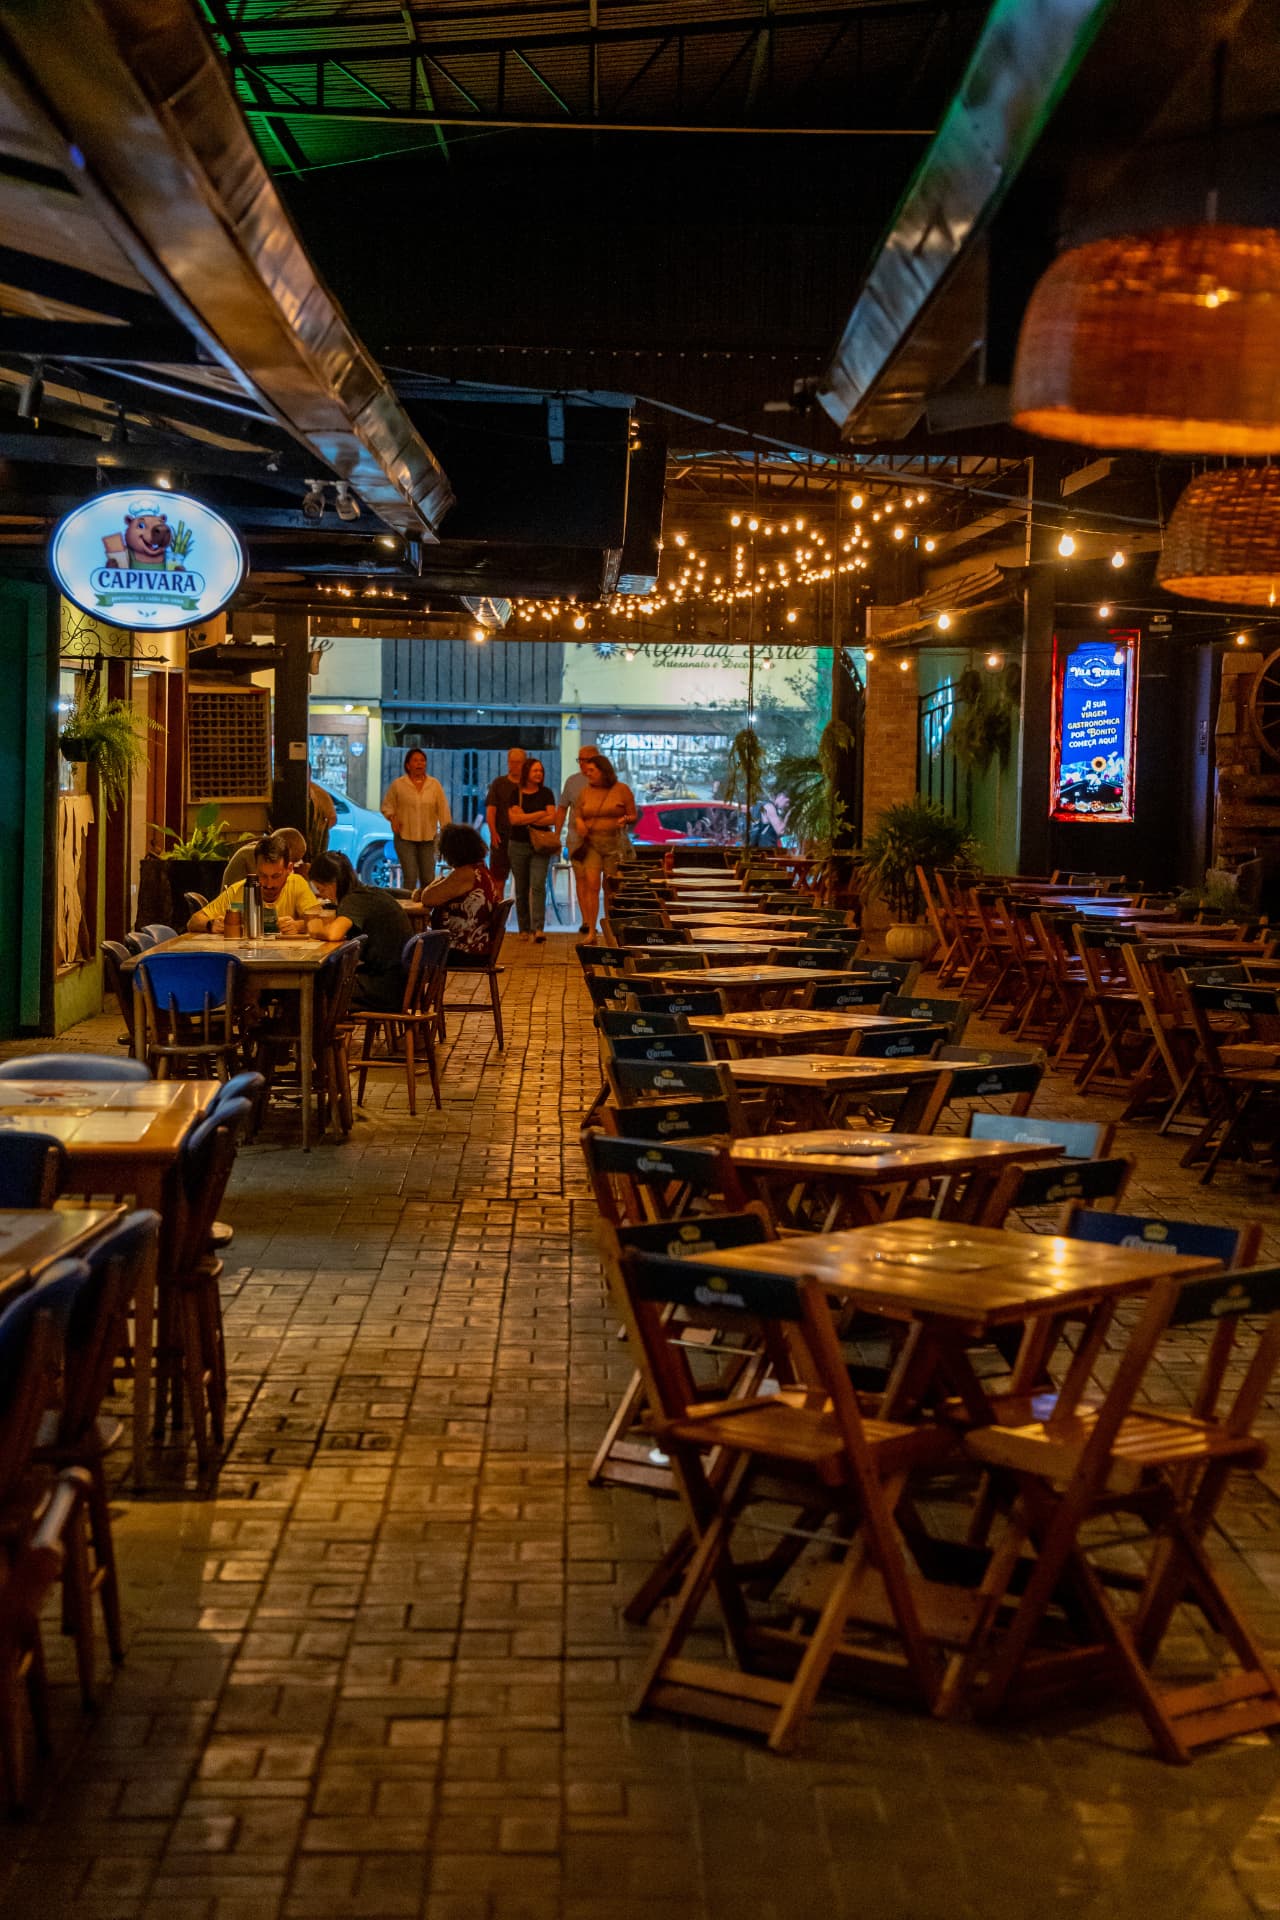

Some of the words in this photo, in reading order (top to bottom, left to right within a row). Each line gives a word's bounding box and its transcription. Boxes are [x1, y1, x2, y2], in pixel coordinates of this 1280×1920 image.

[98, 571, 197, 593] CAPIVARA
[1082, 700, 1091, 711] A
[1093, 700, 1106, 708] SUA
[1069, 739, 1097, 748] COMEÇA
[1099, 735, 1117, 744] AQUI!
